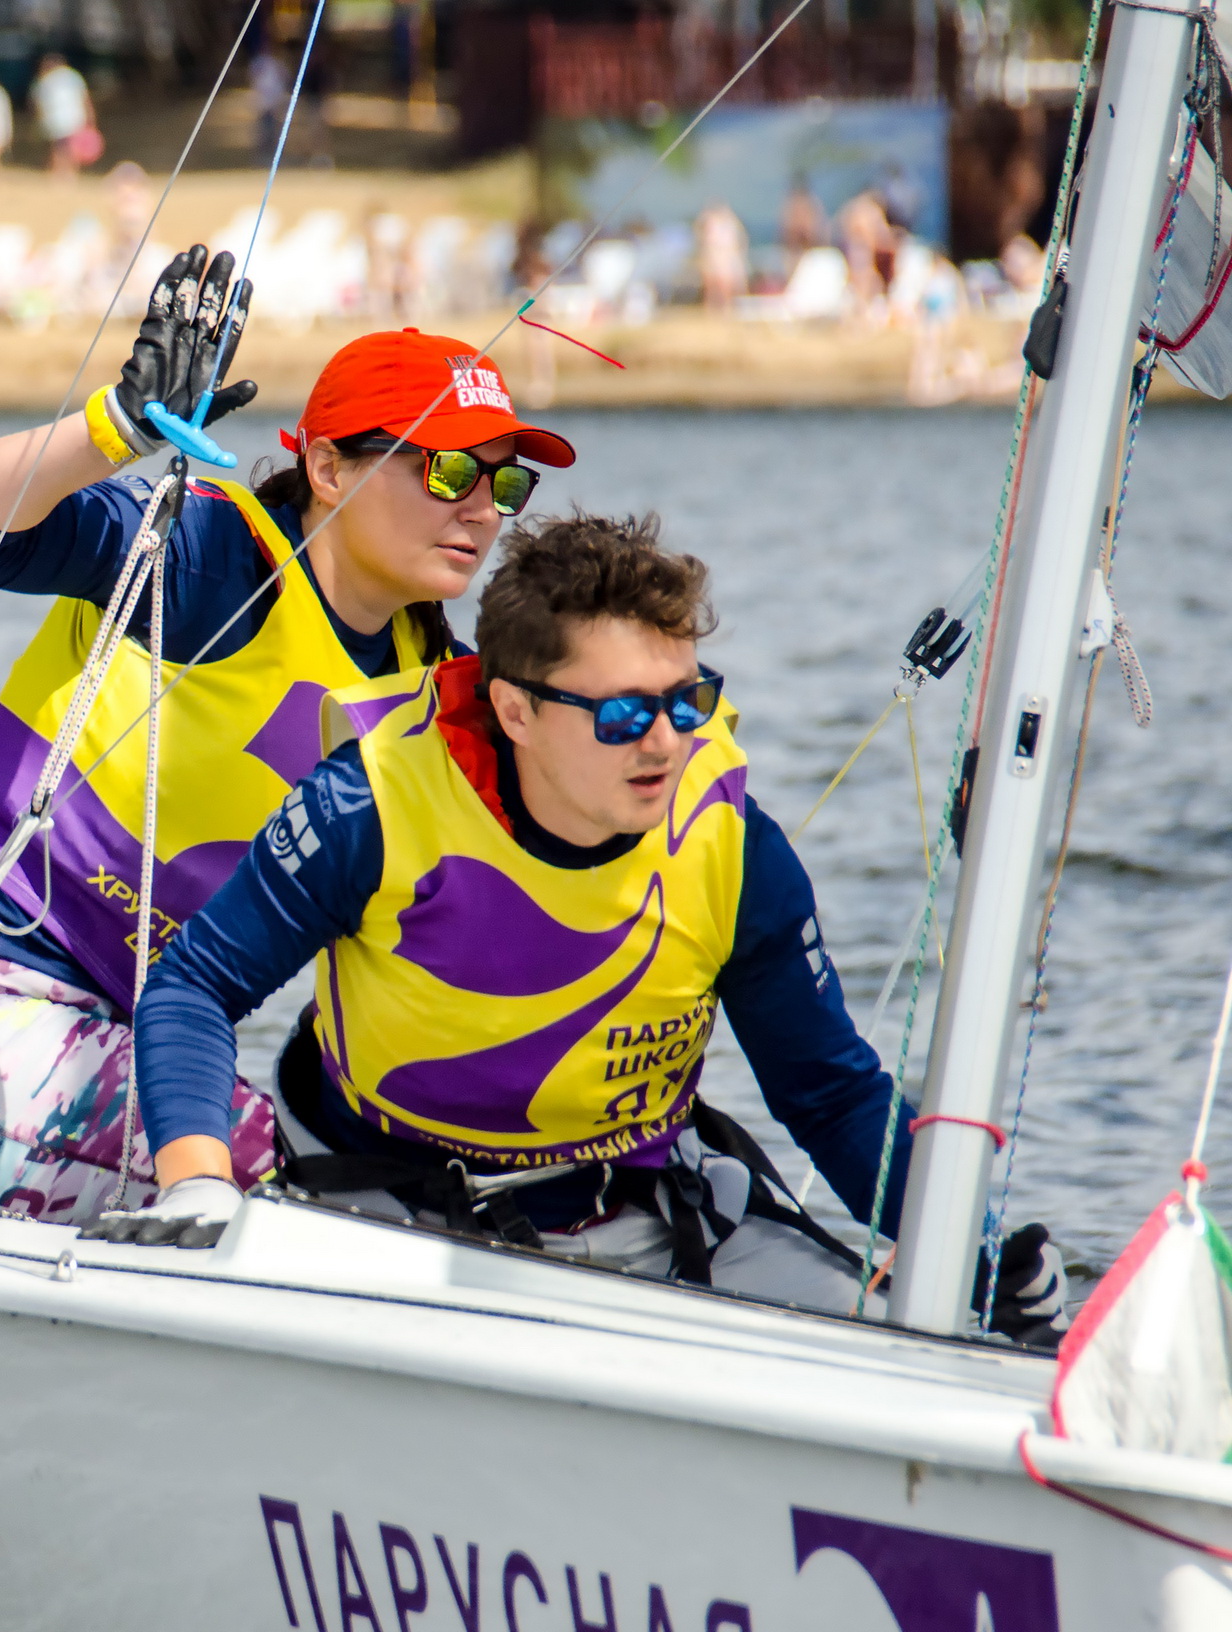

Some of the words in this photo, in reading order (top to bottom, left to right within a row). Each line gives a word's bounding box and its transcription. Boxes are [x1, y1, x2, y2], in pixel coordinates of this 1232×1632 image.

[452, 369, 474, 388] AT
[474, 370, 501, 390] THE
[86, 864, 182, 942] ХРУСТ
